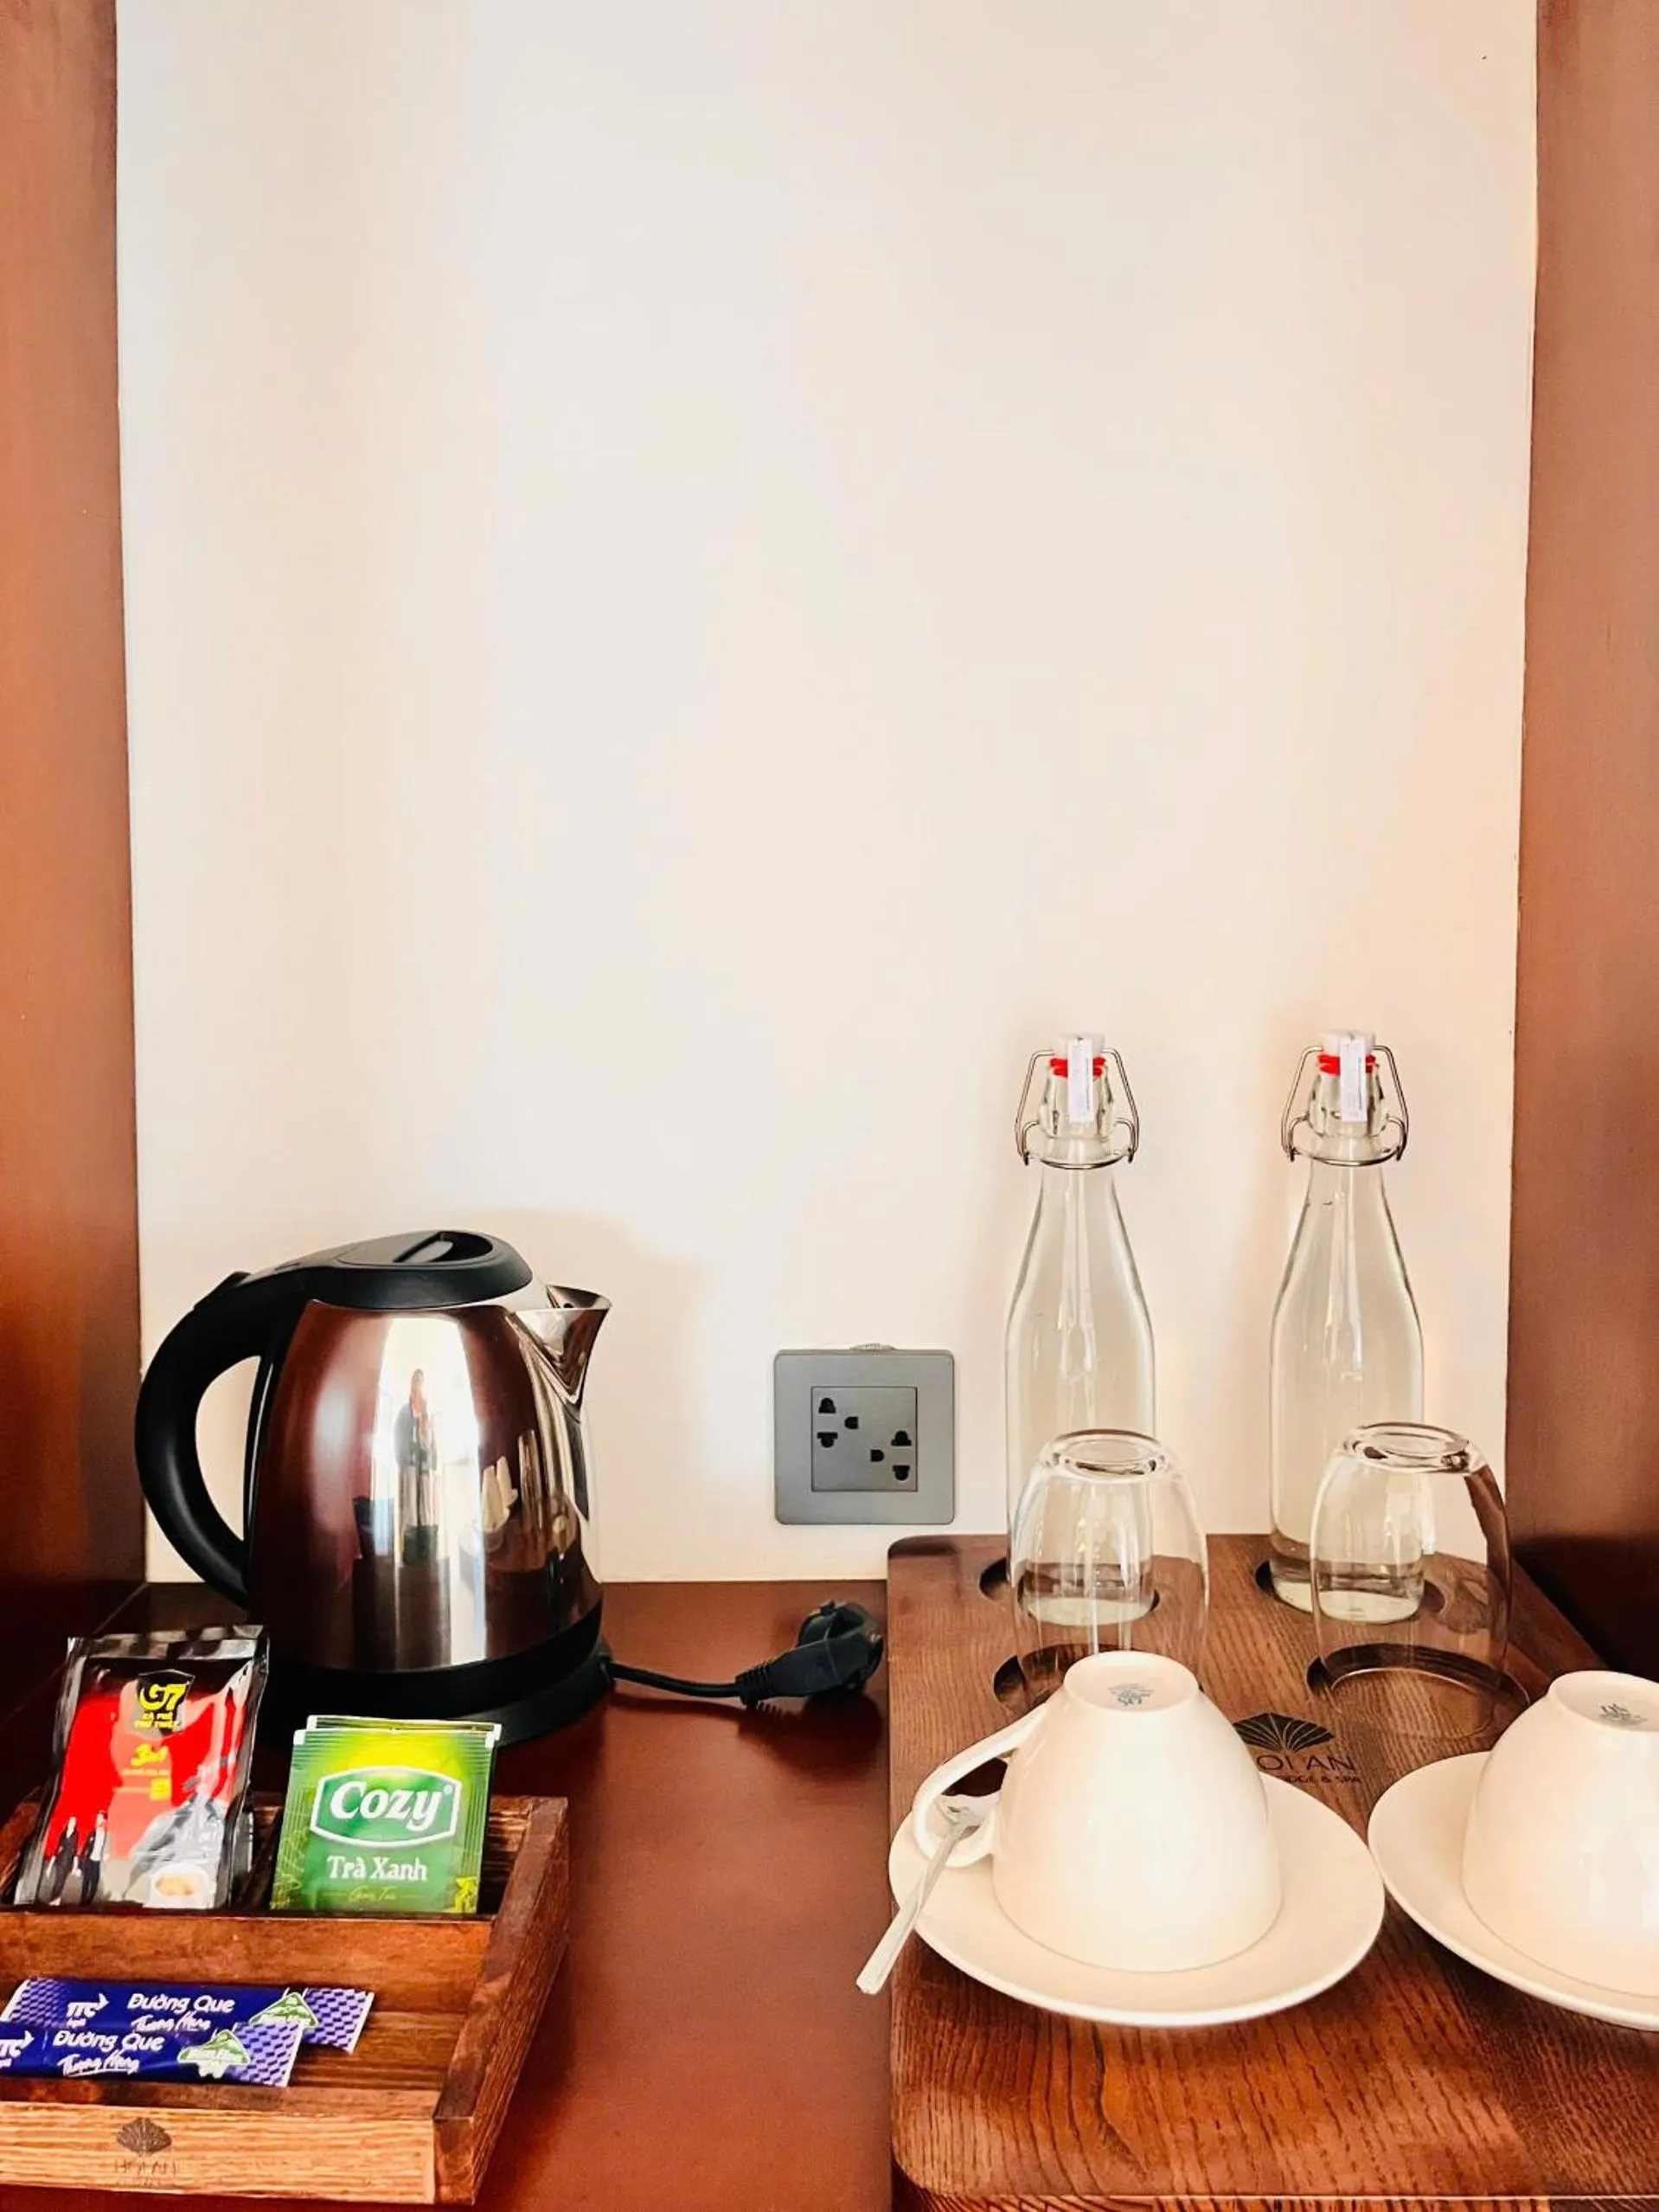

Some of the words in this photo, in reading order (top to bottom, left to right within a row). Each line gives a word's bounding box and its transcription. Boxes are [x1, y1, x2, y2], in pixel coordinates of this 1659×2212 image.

[139, 1683, 187, 1711] G7
[1257, 1754, 1293, 1770] OI
[1306, 1755, 1355, 1770] AN
[329, 1780, 443, 1832] Cozy
[326, 1855, 366, 1879] Trà
[369, 1856, 427, 1881] Xanh
[193, 1995, 235, 2013] Que
[122, 2032, 165, 2052] Que
